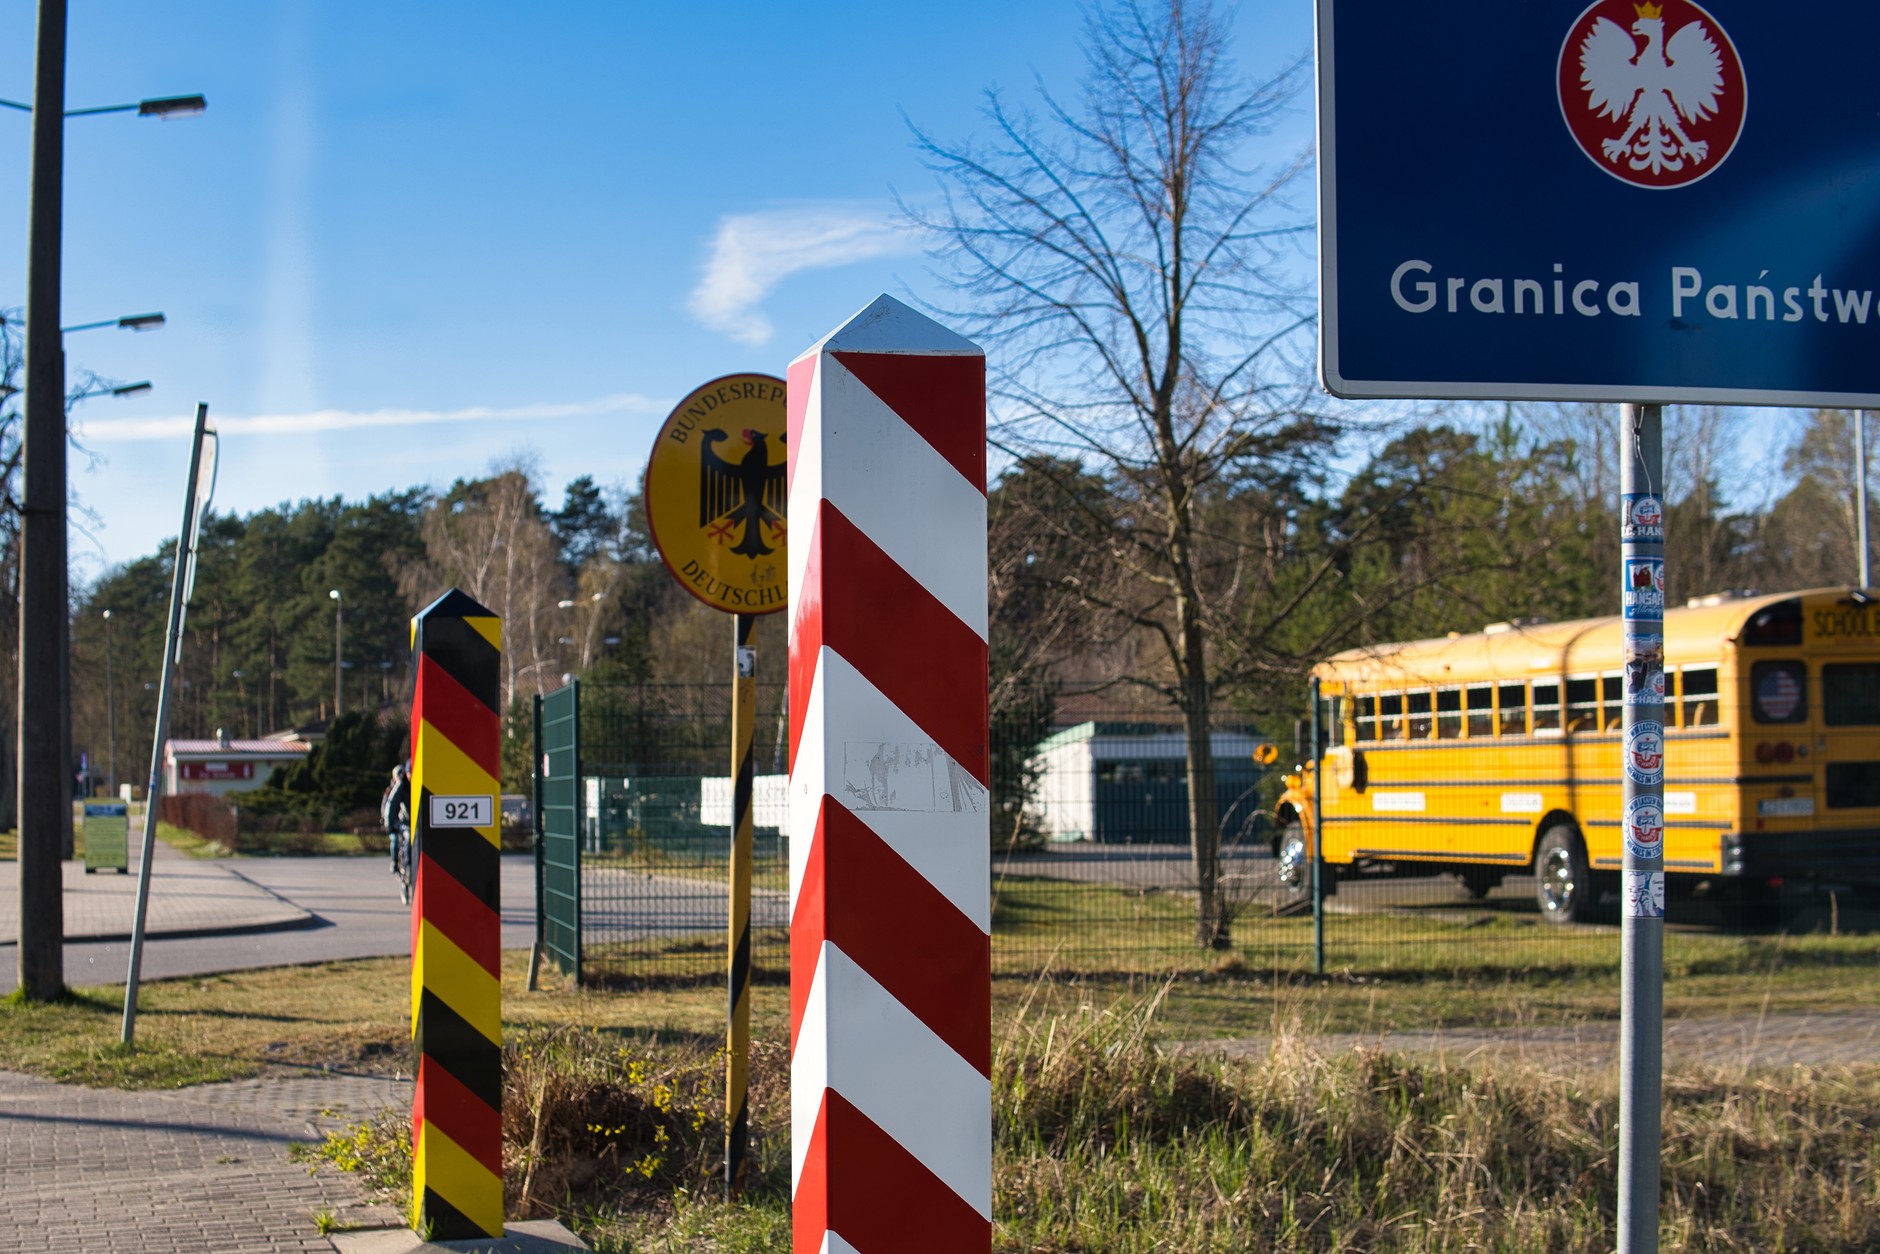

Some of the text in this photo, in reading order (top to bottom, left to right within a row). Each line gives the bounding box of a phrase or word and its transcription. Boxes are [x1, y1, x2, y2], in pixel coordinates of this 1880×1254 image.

[1390, 259, 1880, 325] Granica Państw
[670, 381, 787, 445] BUNDESREP
[681, 560, 787, 606] DEUTSCHL
[1813, 610, 1872, 638] SCHOOL
[445, 802, 479, 820] 921
